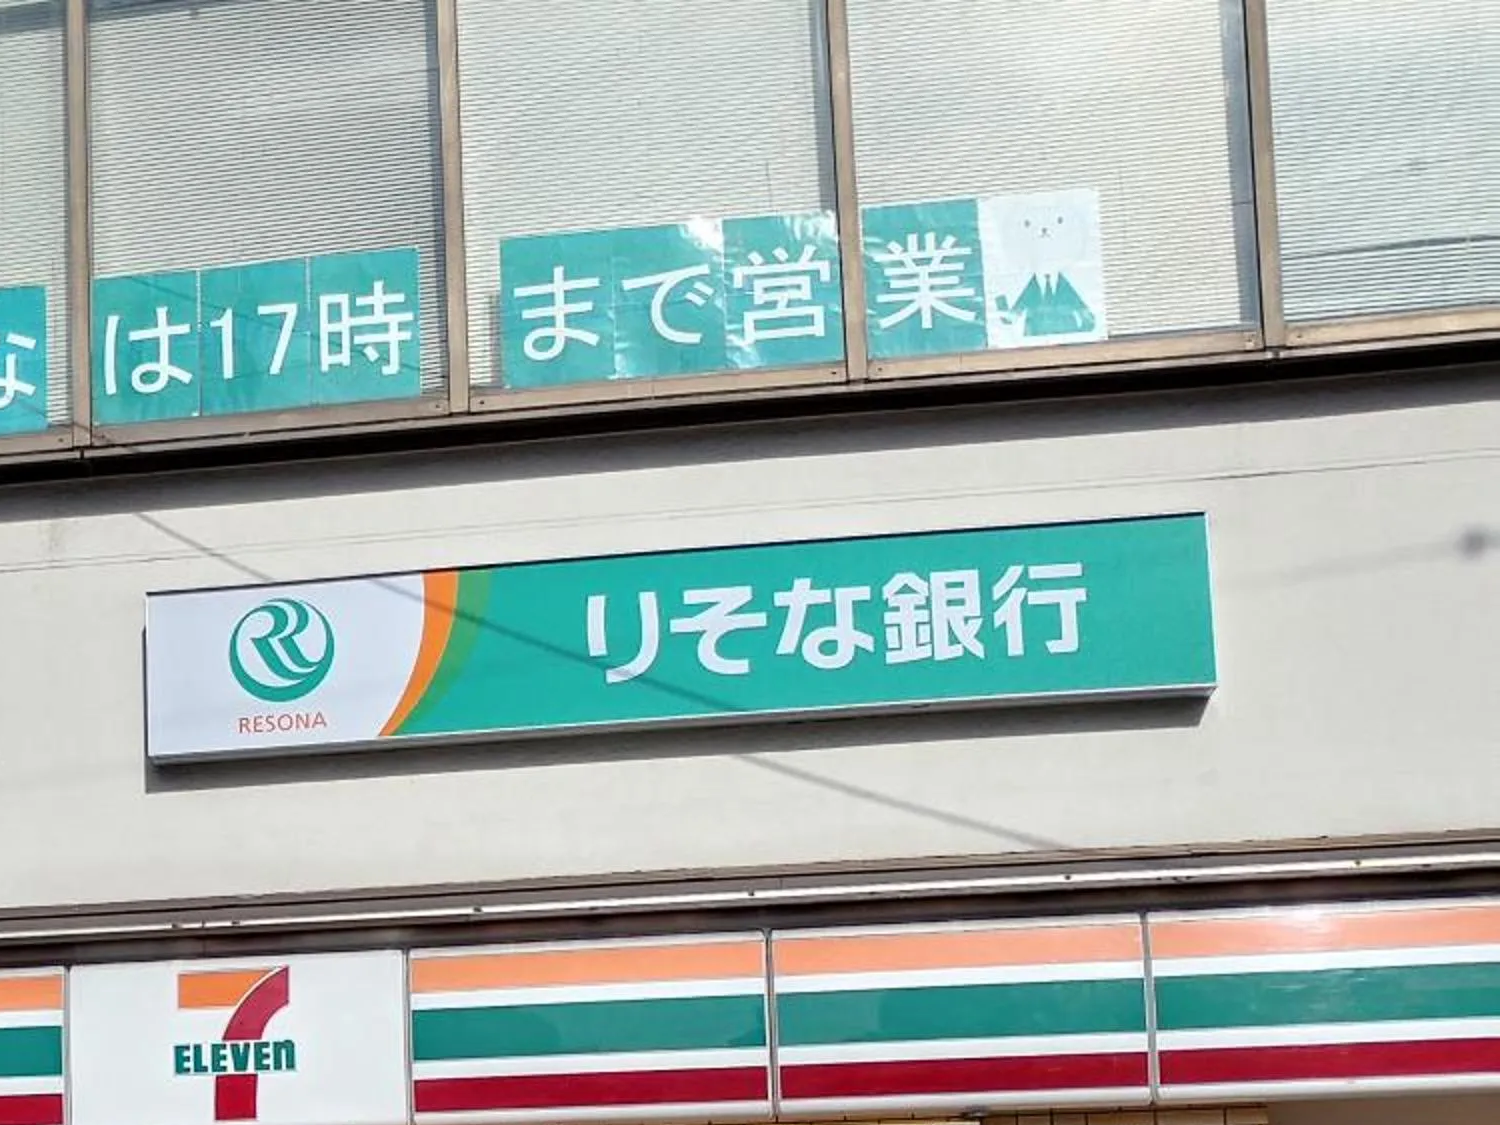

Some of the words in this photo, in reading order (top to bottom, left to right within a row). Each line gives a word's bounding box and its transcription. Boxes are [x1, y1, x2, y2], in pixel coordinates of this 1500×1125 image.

[585, 562, 1088, 685] りそな銀行
[238, 710, 328, 734] RESONA
[173, 1038, 296, 1075] ELEVEN
